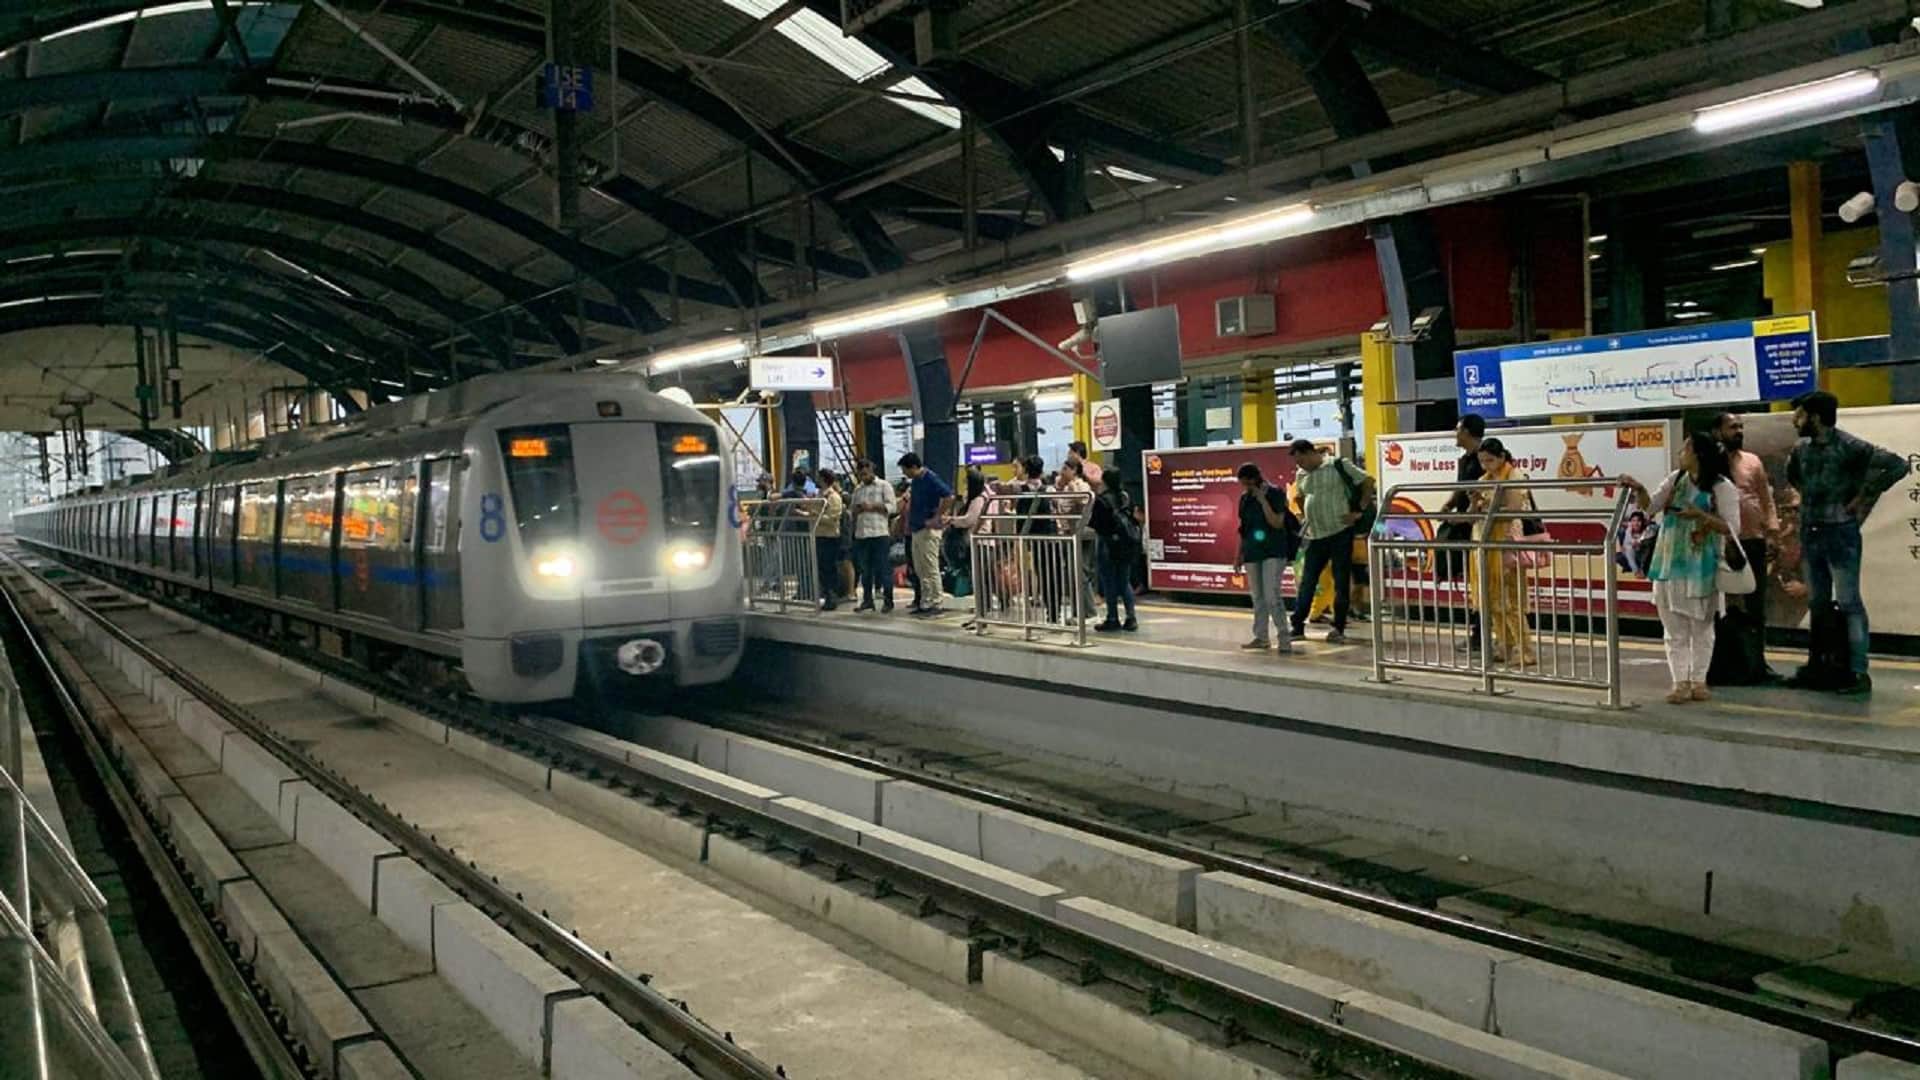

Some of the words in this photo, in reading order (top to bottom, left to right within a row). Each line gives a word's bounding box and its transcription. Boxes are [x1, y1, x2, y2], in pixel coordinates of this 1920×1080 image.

[1466, 397, 1498, 406] Platform
[1638, 427, 1663, 447] pnb
[1410, 459, 1431, 471] Now
[1432, 458, 1456, 471] Less
[1512, 457, 1528, 468] ore
[1530, 453, 1547, 471] joy
[479, 493, 506, 543] 8
